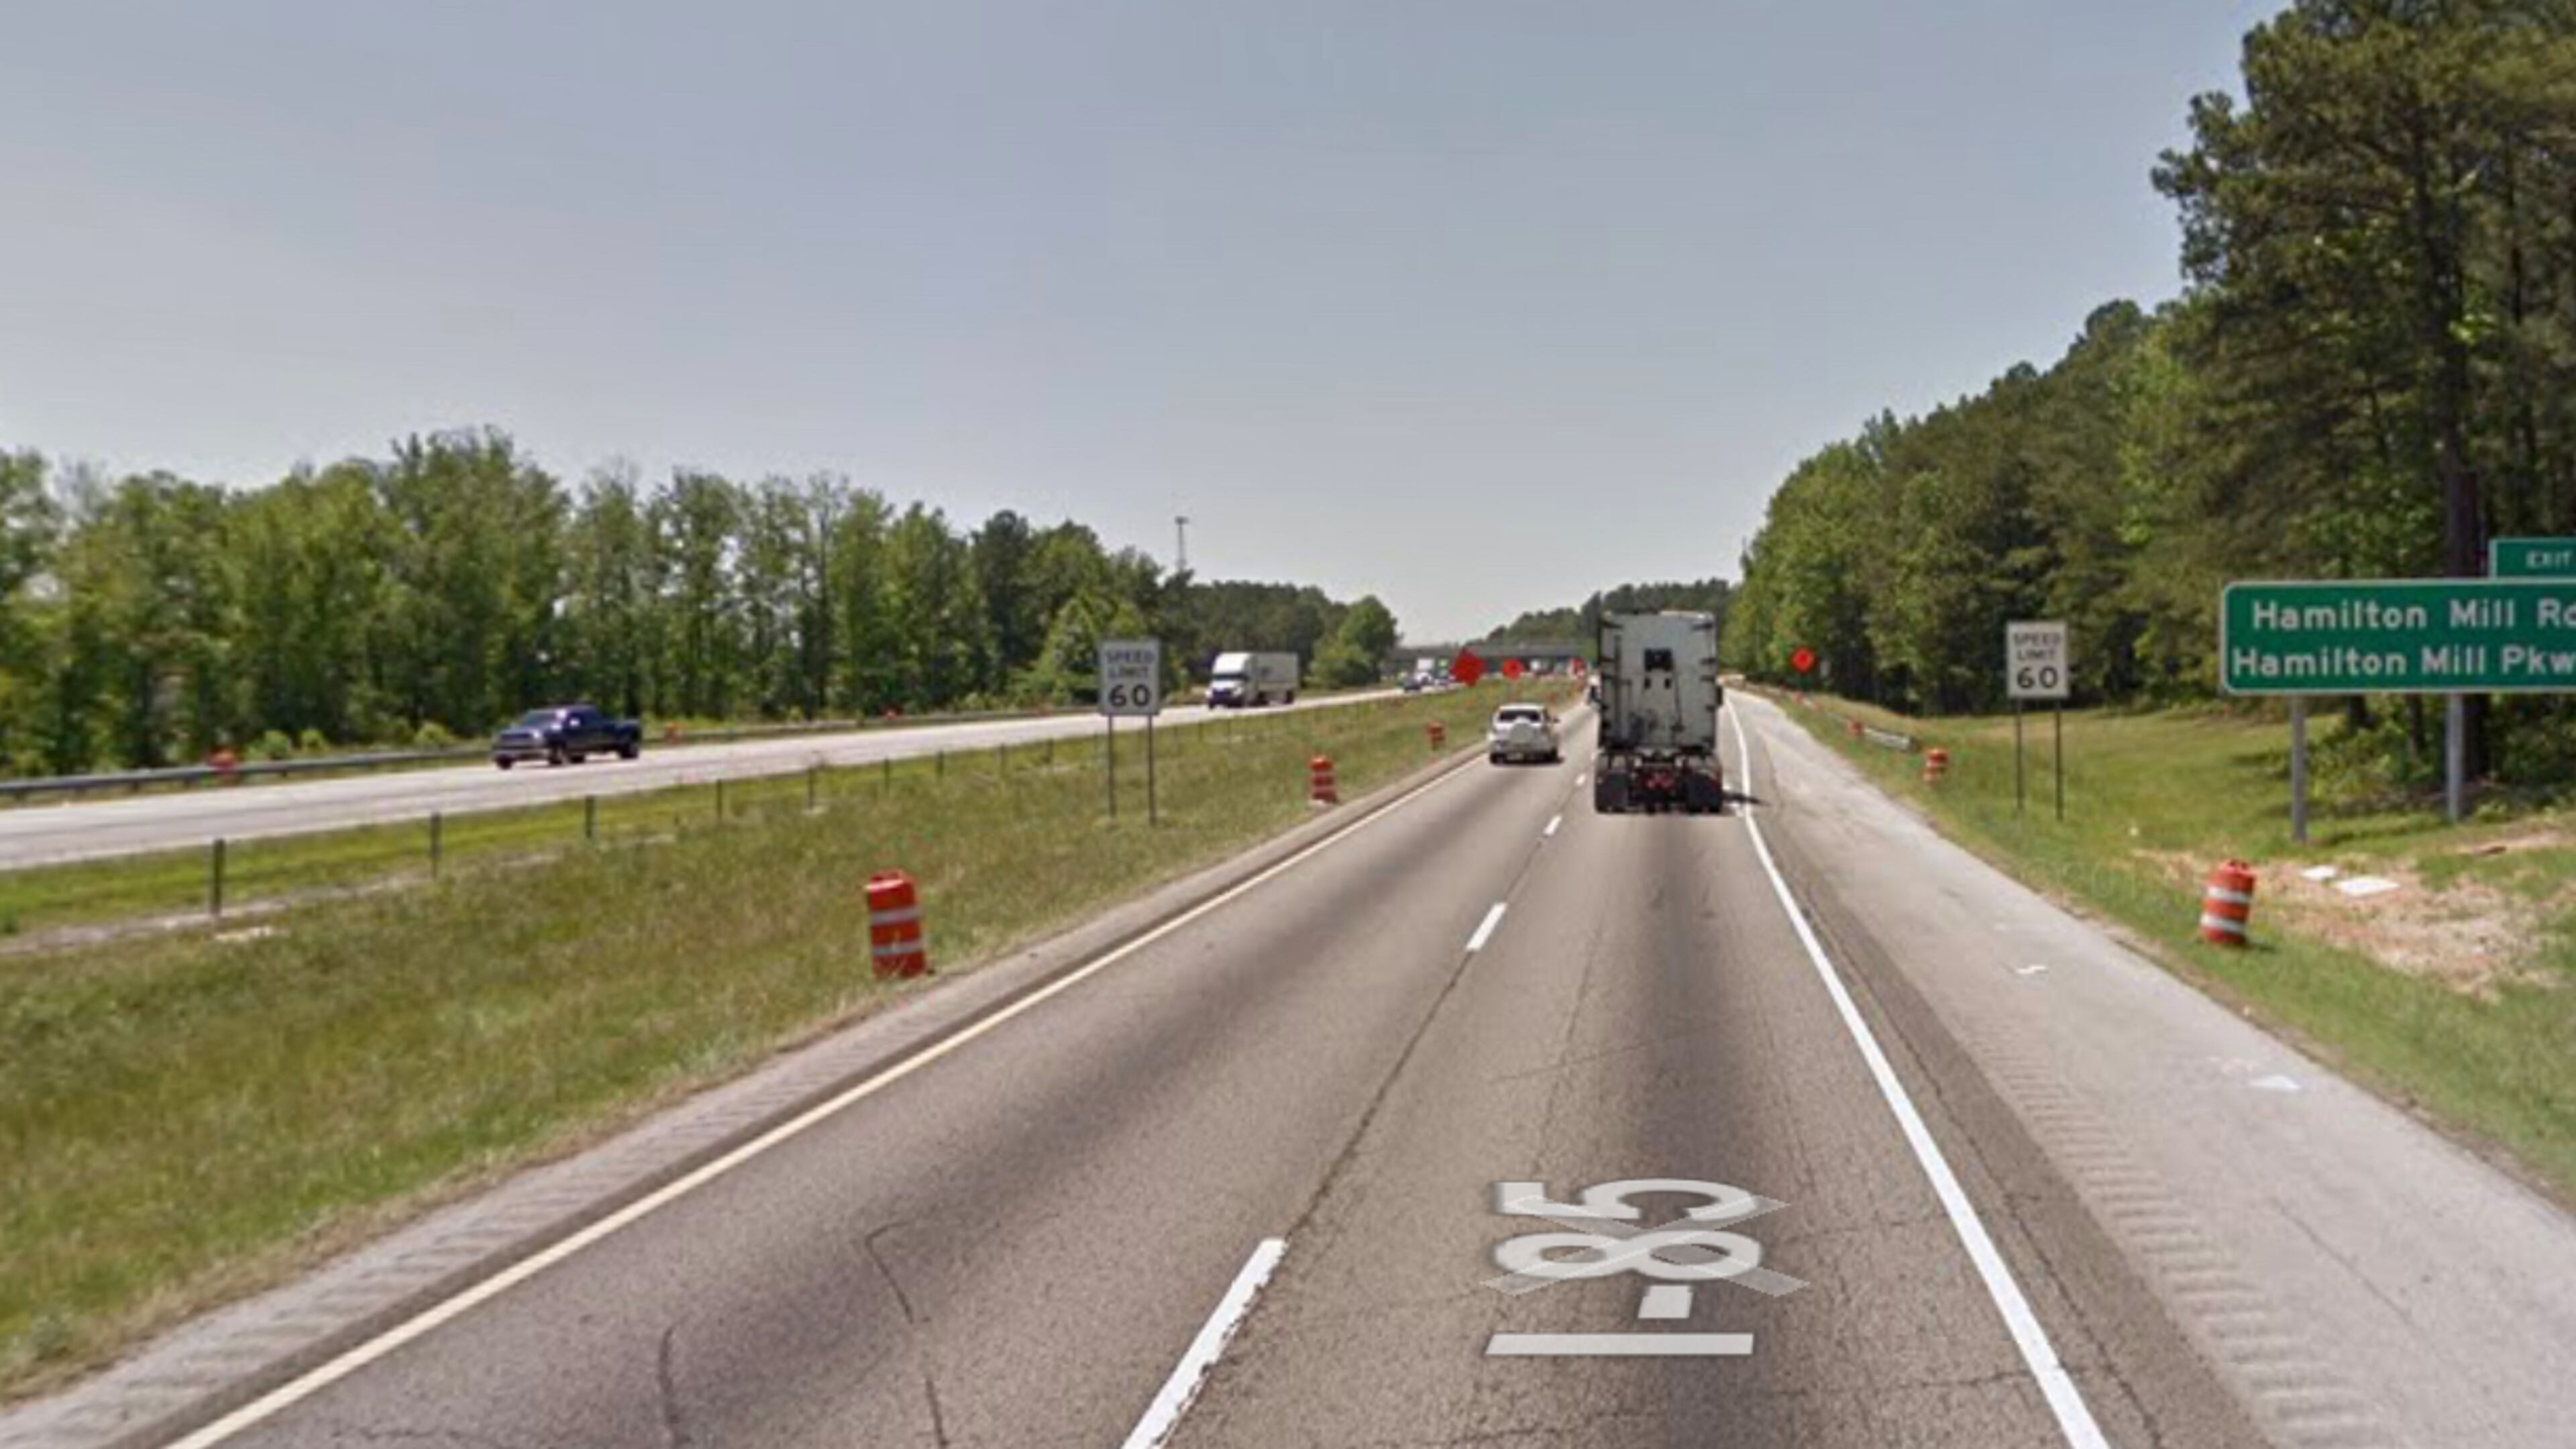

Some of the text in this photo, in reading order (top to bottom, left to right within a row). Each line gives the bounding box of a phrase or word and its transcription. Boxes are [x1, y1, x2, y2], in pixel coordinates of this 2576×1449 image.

[2526, 550, 2571, 568] EXIT
[2253, 600, 2427, 629] Hamilton
[2450, 598, 2515, 628] Mill
[2015, 633, 2061, 645] SPEED
[1106, 651, 1156, 663] SPEED
[2017, 649, 2055, 661] LIMIT
[2232, 647, 2407, 676] Hamilton
[2421, 646, 2485, 675] Mill
[1108, 666, 1149, 678] LIMIT
[2017, 665, 2058, 690] 60
[1110, 684, 1151, 707] 60
